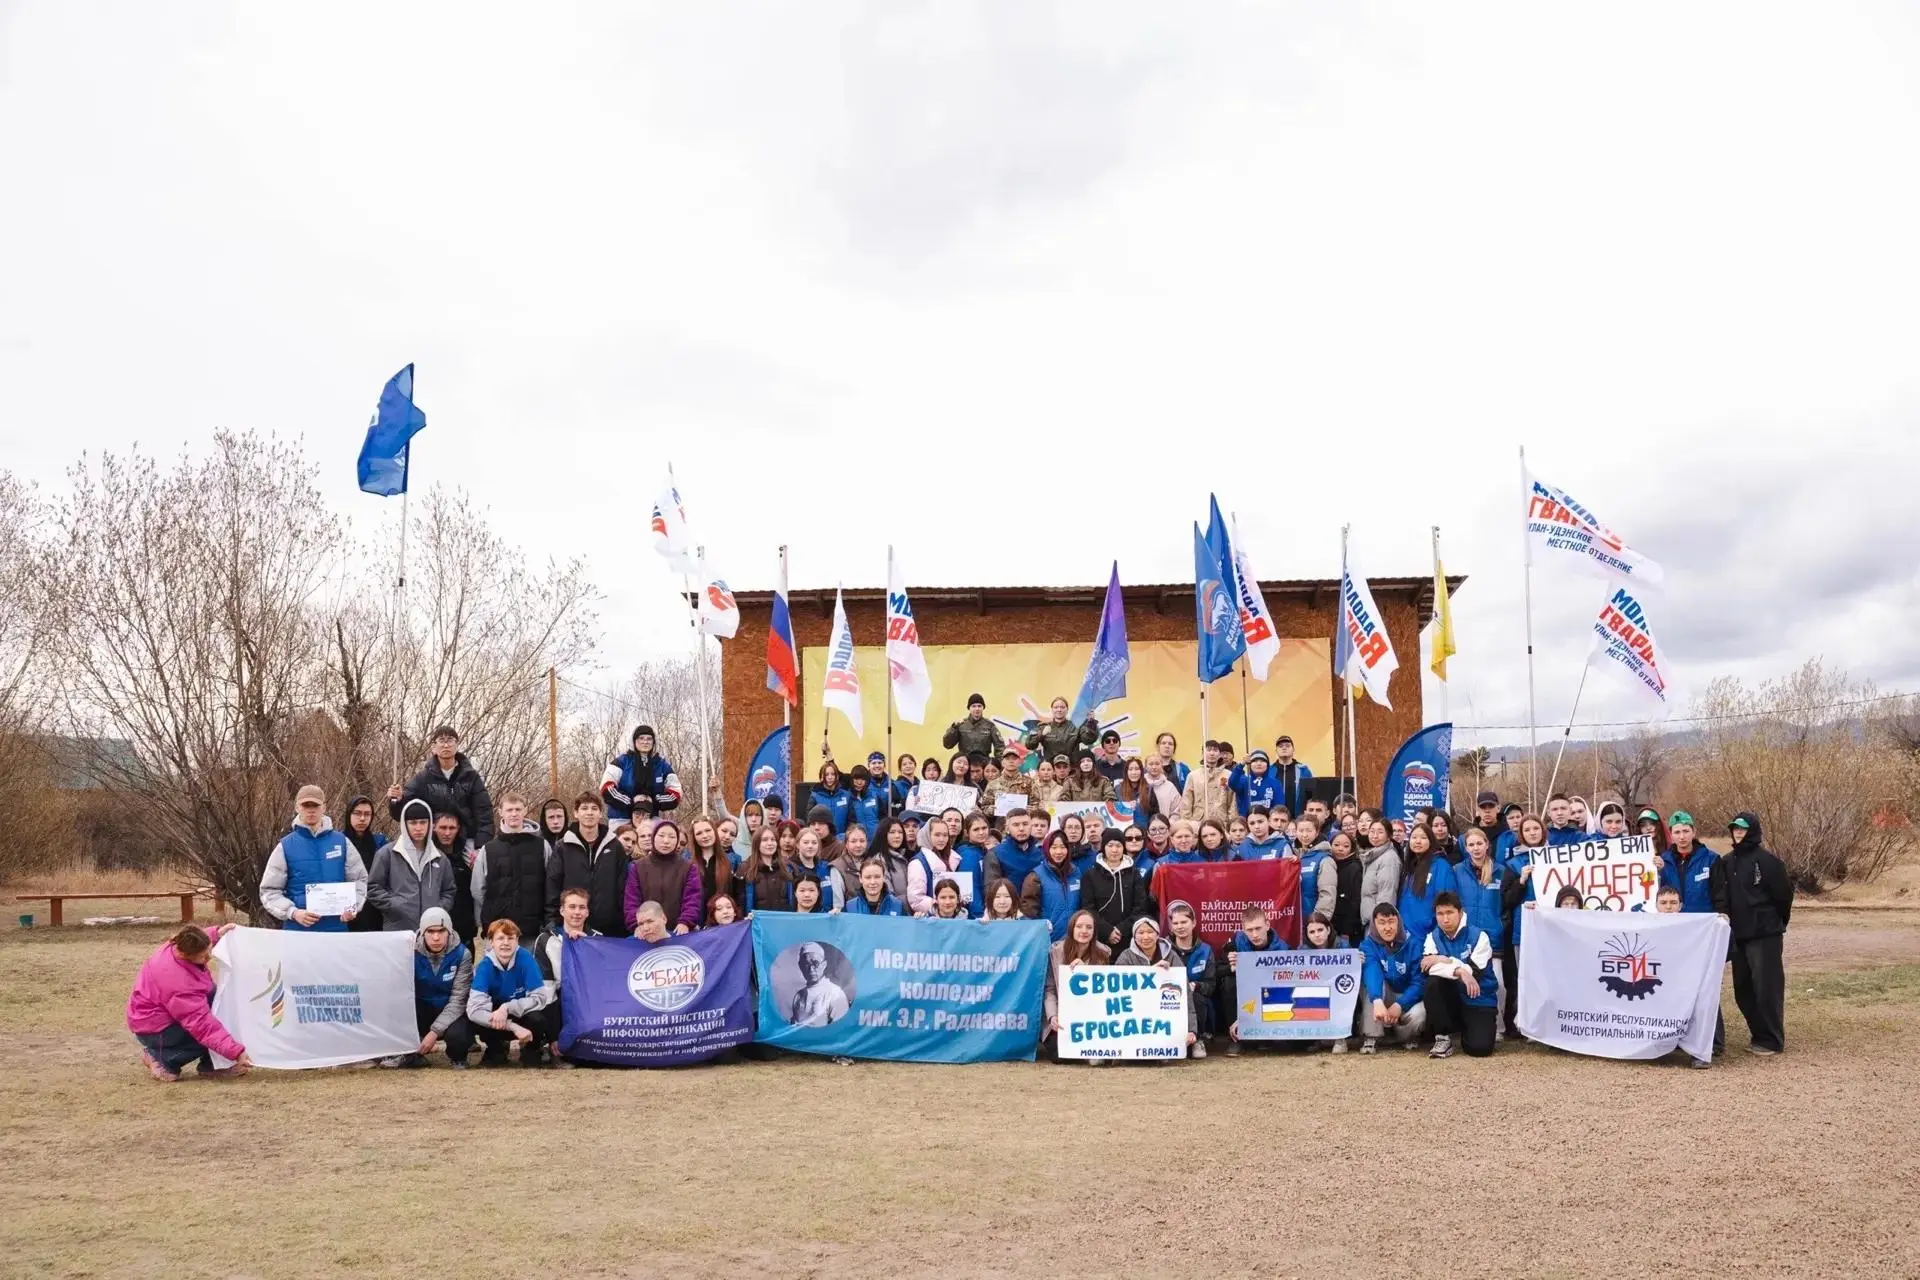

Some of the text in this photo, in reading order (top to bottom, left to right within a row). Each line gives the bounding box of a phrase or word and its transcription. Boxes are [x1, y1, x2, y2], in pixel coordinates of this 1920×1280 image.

[1528, 522, 1593, 544] УЛАН-УДЭНСКОЕ
[1546, 537, 1632, 574] МЕСТНОЕ ОТДЕЛЕНИЕ
[1605, 646, 1637, 673] МЕСТНОЕ
[1531, 843, 1581, 865] МГЕР
[1620, 835, 1651, 854] БРИТ
[1542, 863, 1646, 895] ЛИДЕР
[1201, 922, 1245, 933] КОЛЛЕД
[873, 949, 1020, 973] Медицинский
[1256, 954, 1352, 967] МОЛОДАЯ ГВАРДИЯ
[1601, 954, 1661, 981] БРИТ
[900, 981, 995, 1005] колледж
[1069, 972, 1157, 996] СВОИХ
[297, 1006, 364, 1025] КОЛЛЕДЖ
[1106, 995, 1133, 1016] НЕ
[1557, 1009, 1609, 1024] БУРЯТСКИЙ
[602, 1018, 726, 1038] ИНФОКОММУНИКАЦИЙ
[604, 1008, 726, 1026] БУРЯТСКИЙ ИНСТИТУТ
[858, 1009, 893, 1027] им.
[934, 1009, 1028, 1031] Раднаева
[1070, 1018, 1171, 1043] БРОСАЕМ
[1560, 1023, 1644, 1040] ИНДУСТРИАЛЬНЫЙ
[1080, 1047, 1179, 1057] МОЛОДАЯ ГВАРДИЯ
